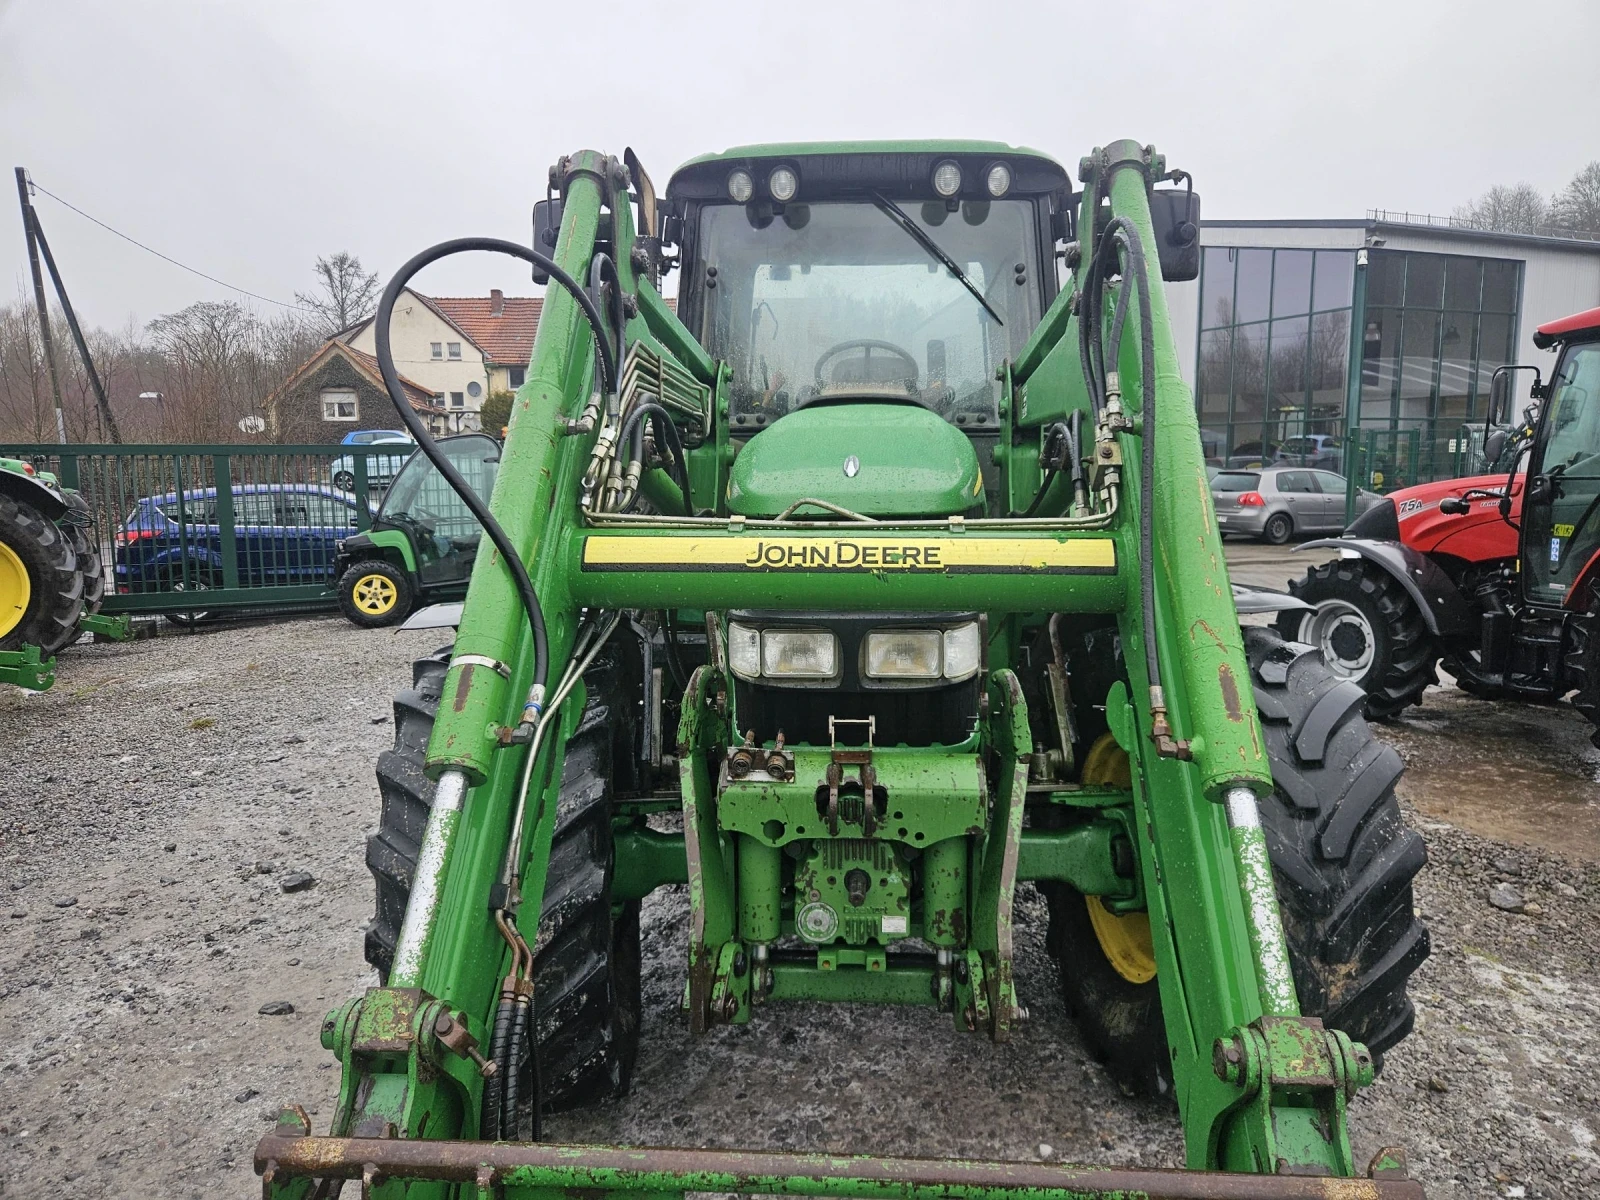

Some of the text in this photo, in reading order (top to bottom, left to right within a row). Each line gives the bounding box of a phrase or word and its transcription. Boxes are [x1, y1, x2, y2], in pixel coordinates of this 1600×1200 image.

[1399, 498, 1422, 513] 75A
[746, 542, 941, 565] JOHN DEERE
